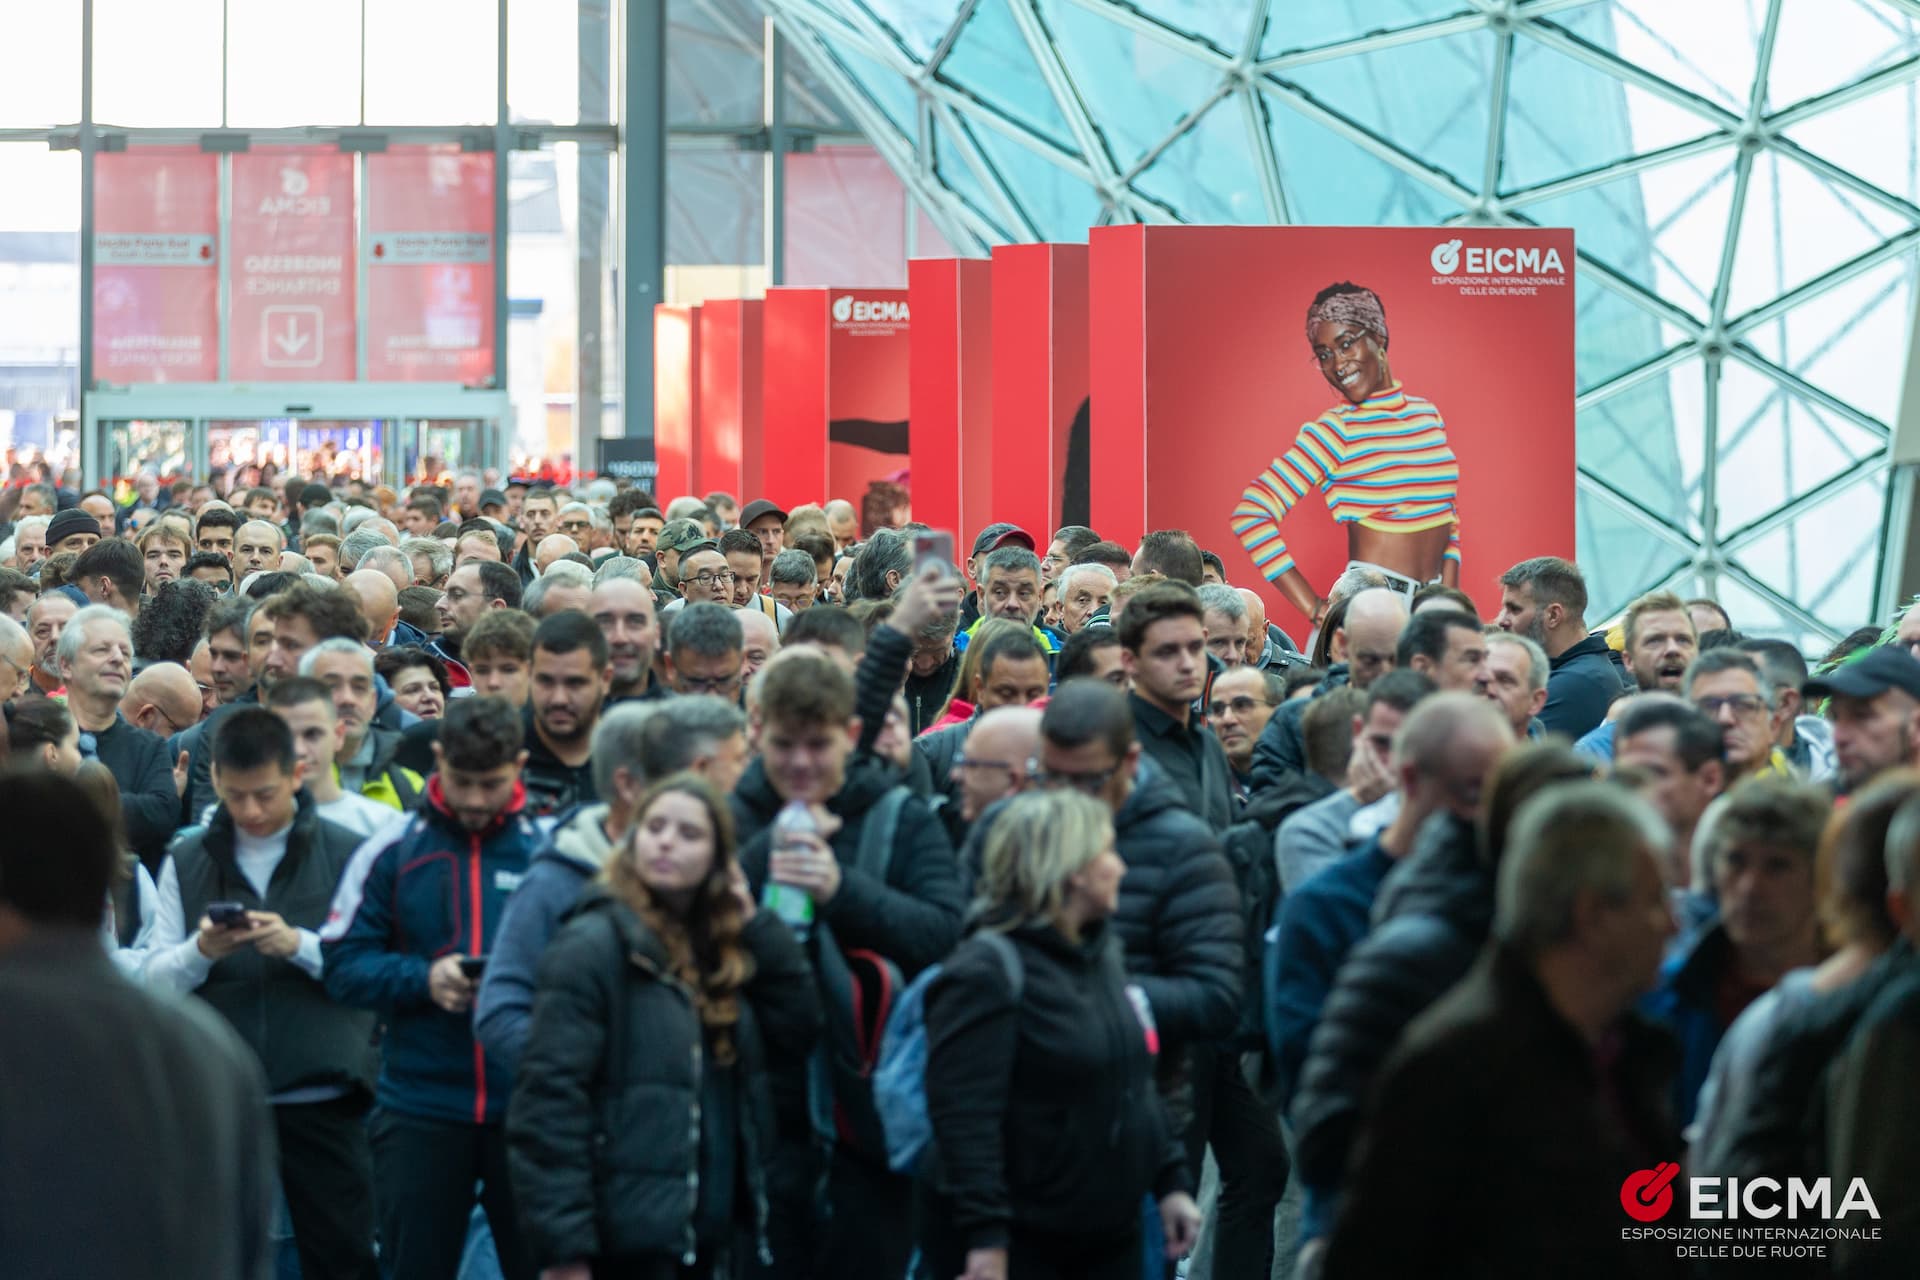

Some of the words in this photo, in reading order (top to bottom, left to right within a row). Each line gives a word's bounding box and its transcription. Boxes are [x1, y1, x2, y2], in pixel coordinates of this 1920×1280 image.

[1466, 248, 1565, 274] EICMA
[1432, 276, 1490, 285] ESPOSIZIONE
[1491, 276, 1566, 285] INTERNAZIONALE
[1460, 287, 1487, 296] DELLE
[1488, 287, 1507, 296] DUE
[1508, 287, 1537, 296] RUOTE
[853, 301, 910, 321] EICMA
